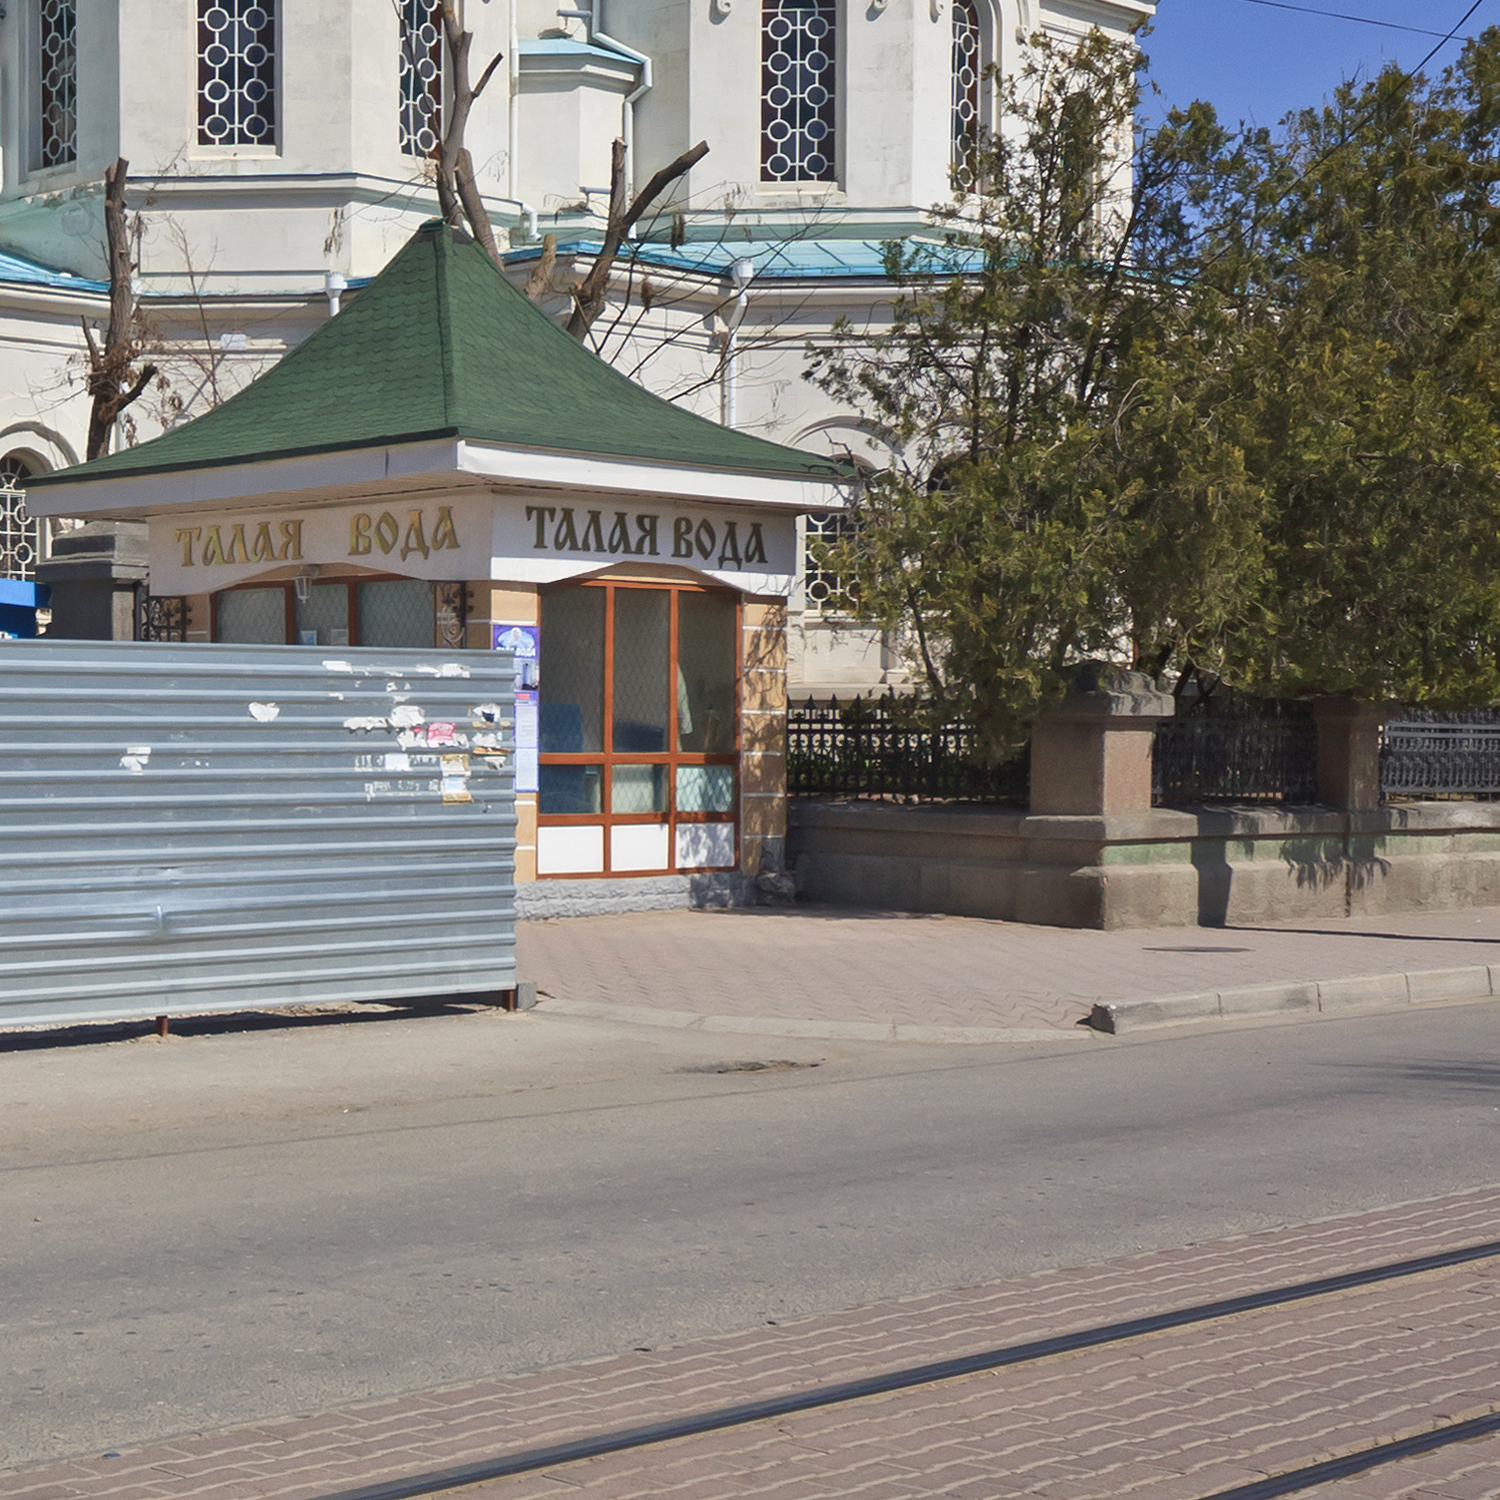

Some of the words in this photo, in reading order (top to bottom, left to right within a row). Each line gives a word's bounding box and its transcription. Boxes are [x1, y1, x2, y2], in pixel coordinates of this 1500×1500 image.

[175, 519, 304, 567] ТАЛАЯ
[347, 506, 461, 562] ВОДА
[525, 505, 661, 556] ТАЛАЯ
[671, 516, 768, 571] ВОДА
